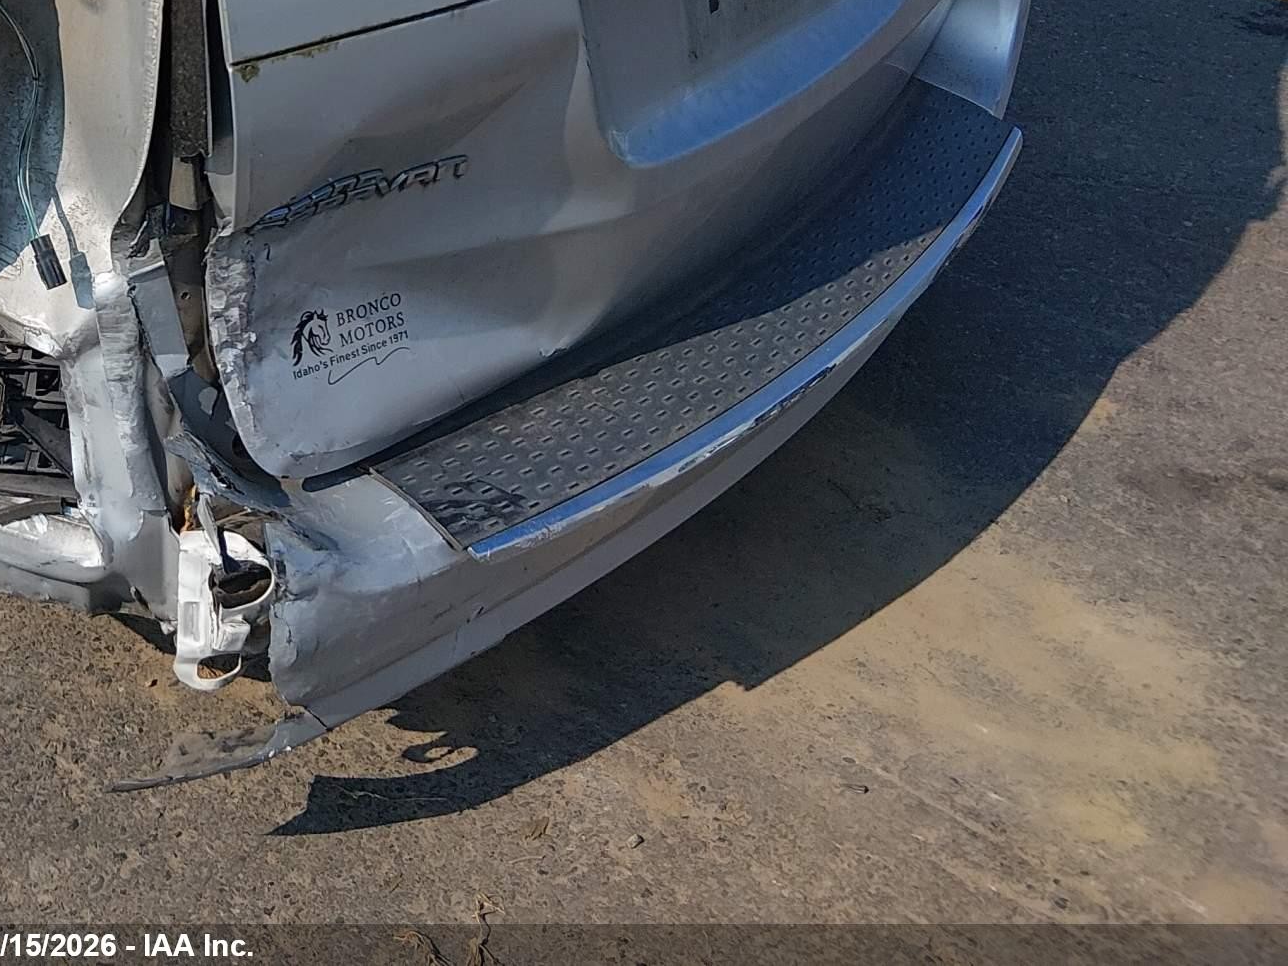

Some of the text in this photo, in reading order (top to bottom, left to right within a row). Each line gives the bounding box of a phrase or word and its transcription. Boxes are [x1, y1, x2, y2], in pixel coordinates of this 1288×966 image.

[336, 293, 402, 327] BRONCO
[339, 311, 405, 348] MOTORS
[292, 330, 409, 380] Idaho's Finest Since 1971
